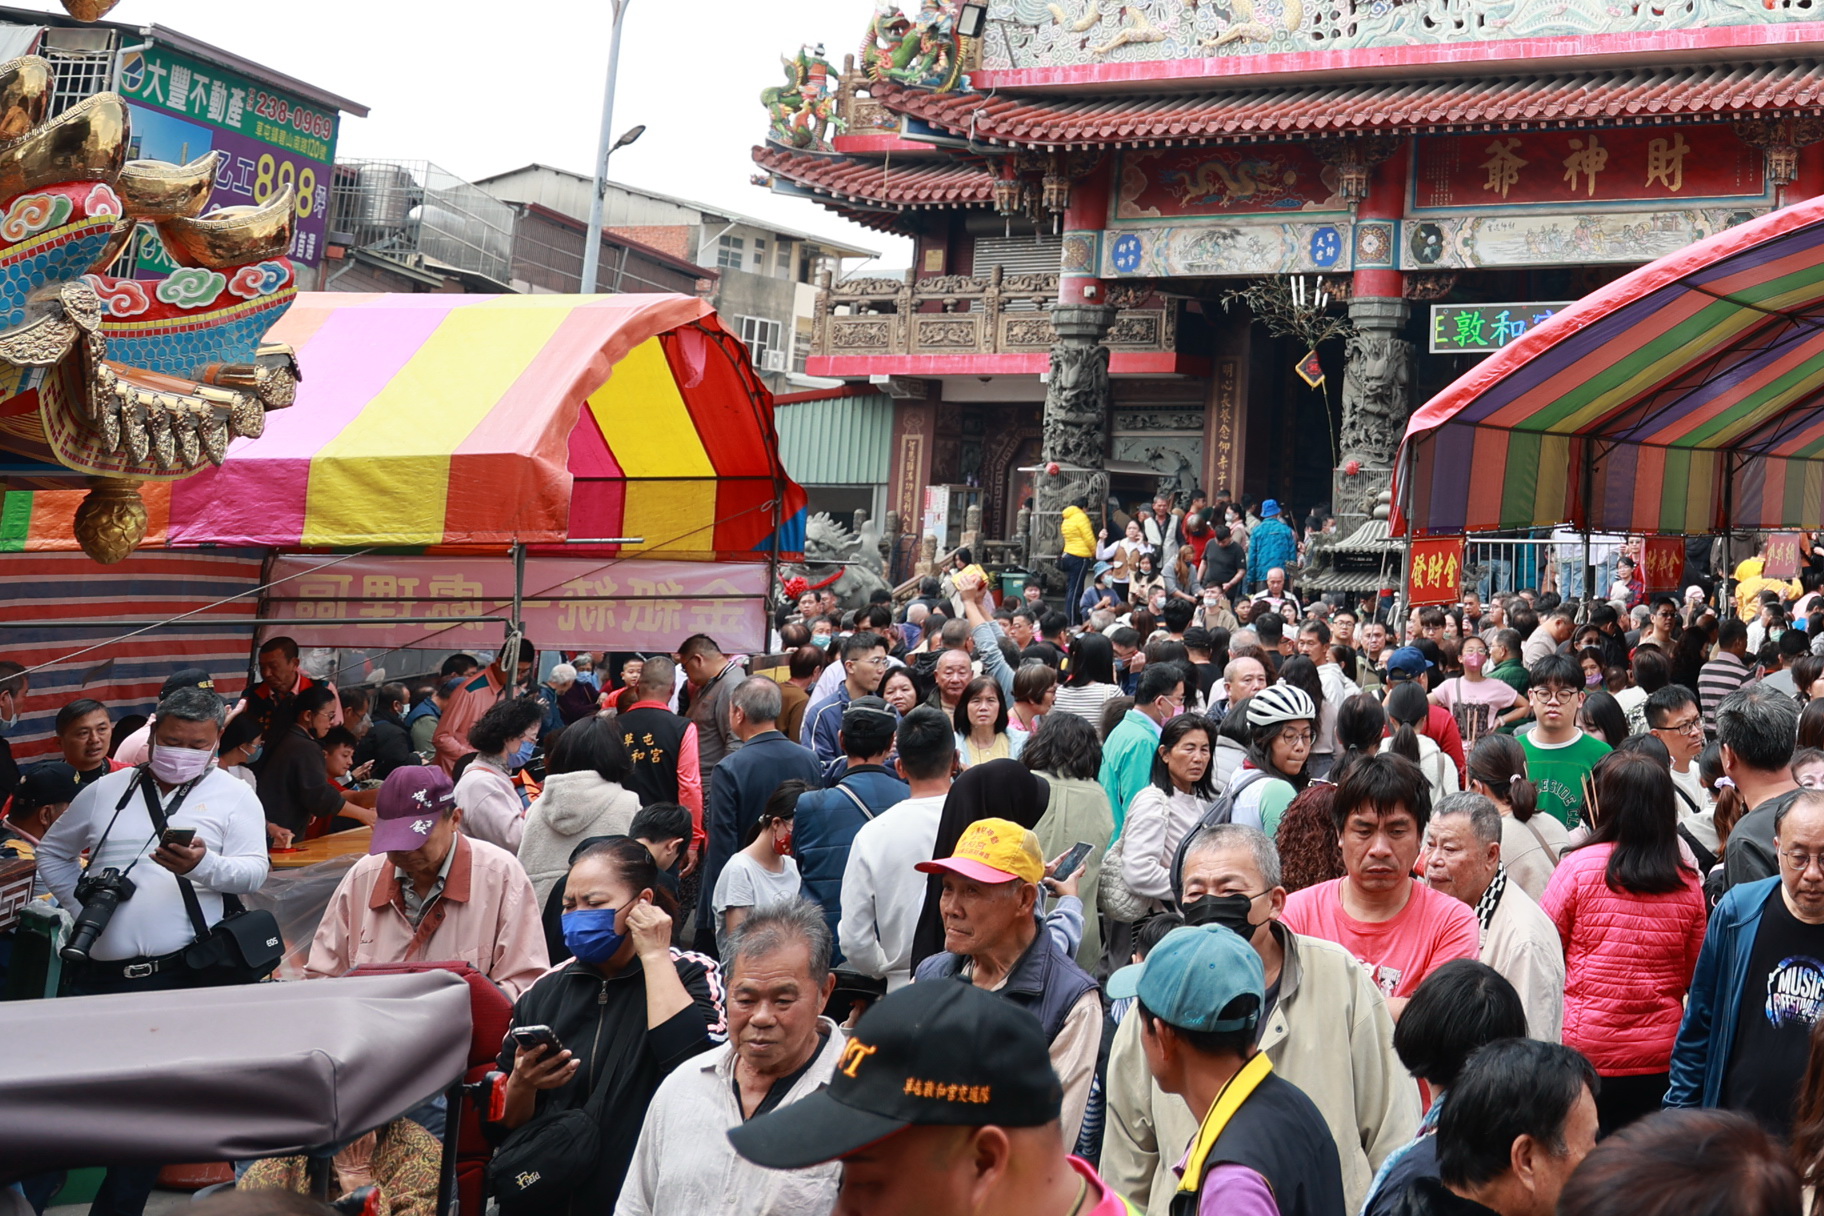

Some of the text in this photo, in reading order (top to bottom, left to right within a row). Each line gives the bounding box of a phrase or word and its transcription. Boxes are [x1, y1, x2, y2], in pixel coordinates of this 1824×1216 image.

[142, 58, 248, 128] 大豐不動產
[255, 92, 332, 140] 238-0969
[1478, 132, 1690, 199] 財神爺
[1410, 551, 1458, 590] 發財金
[624, 732, 655, 747] 草屯
[630, 748, 664, 764] 和宮
